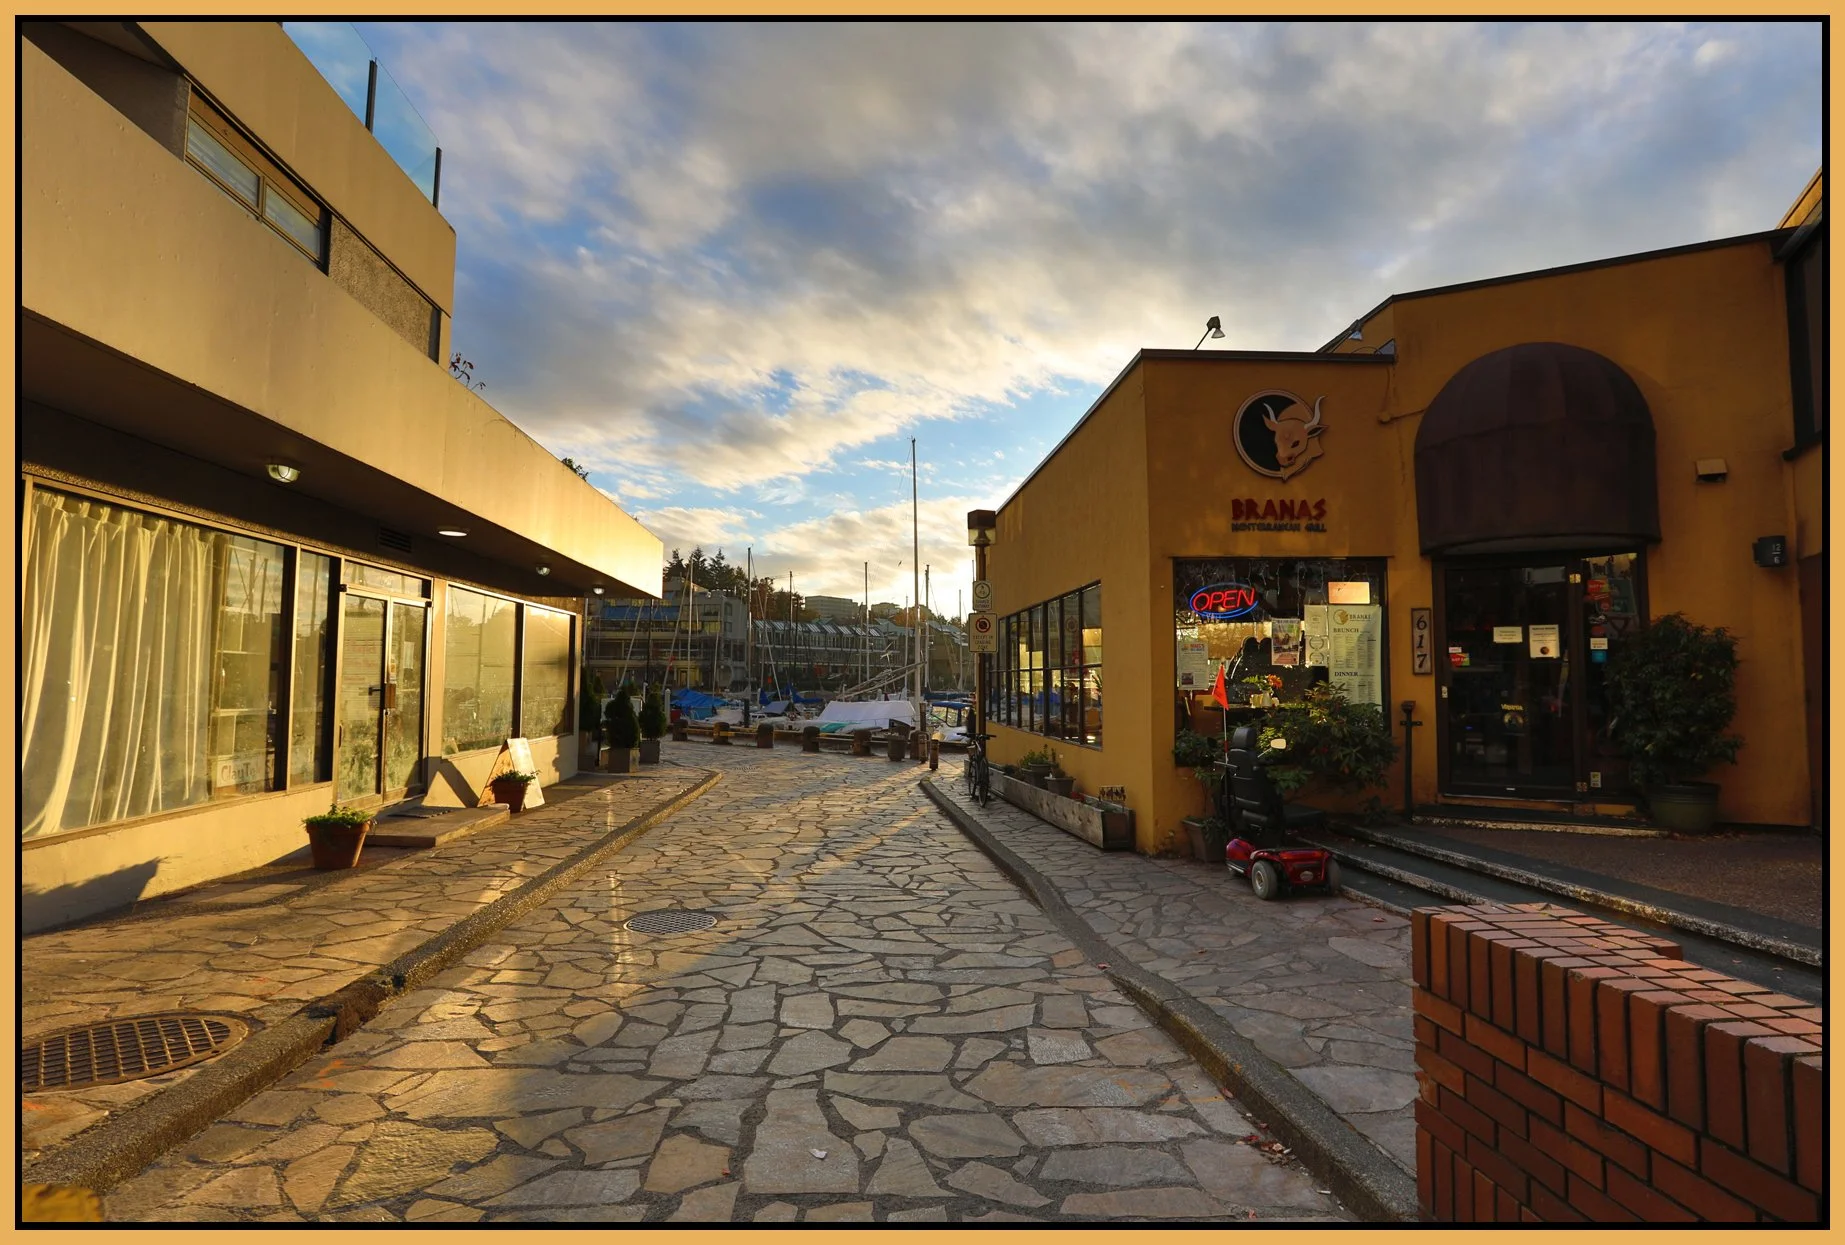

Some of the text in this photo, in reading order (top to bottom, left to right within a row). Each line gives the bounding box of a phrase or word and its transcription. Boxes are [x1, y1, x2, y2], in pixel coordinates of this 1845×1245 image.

[1232, 498, 1327, 521] BRANAS
[1193, 587, 1255, 611] OPEN
[1416, 615, 1427, 669] 617
